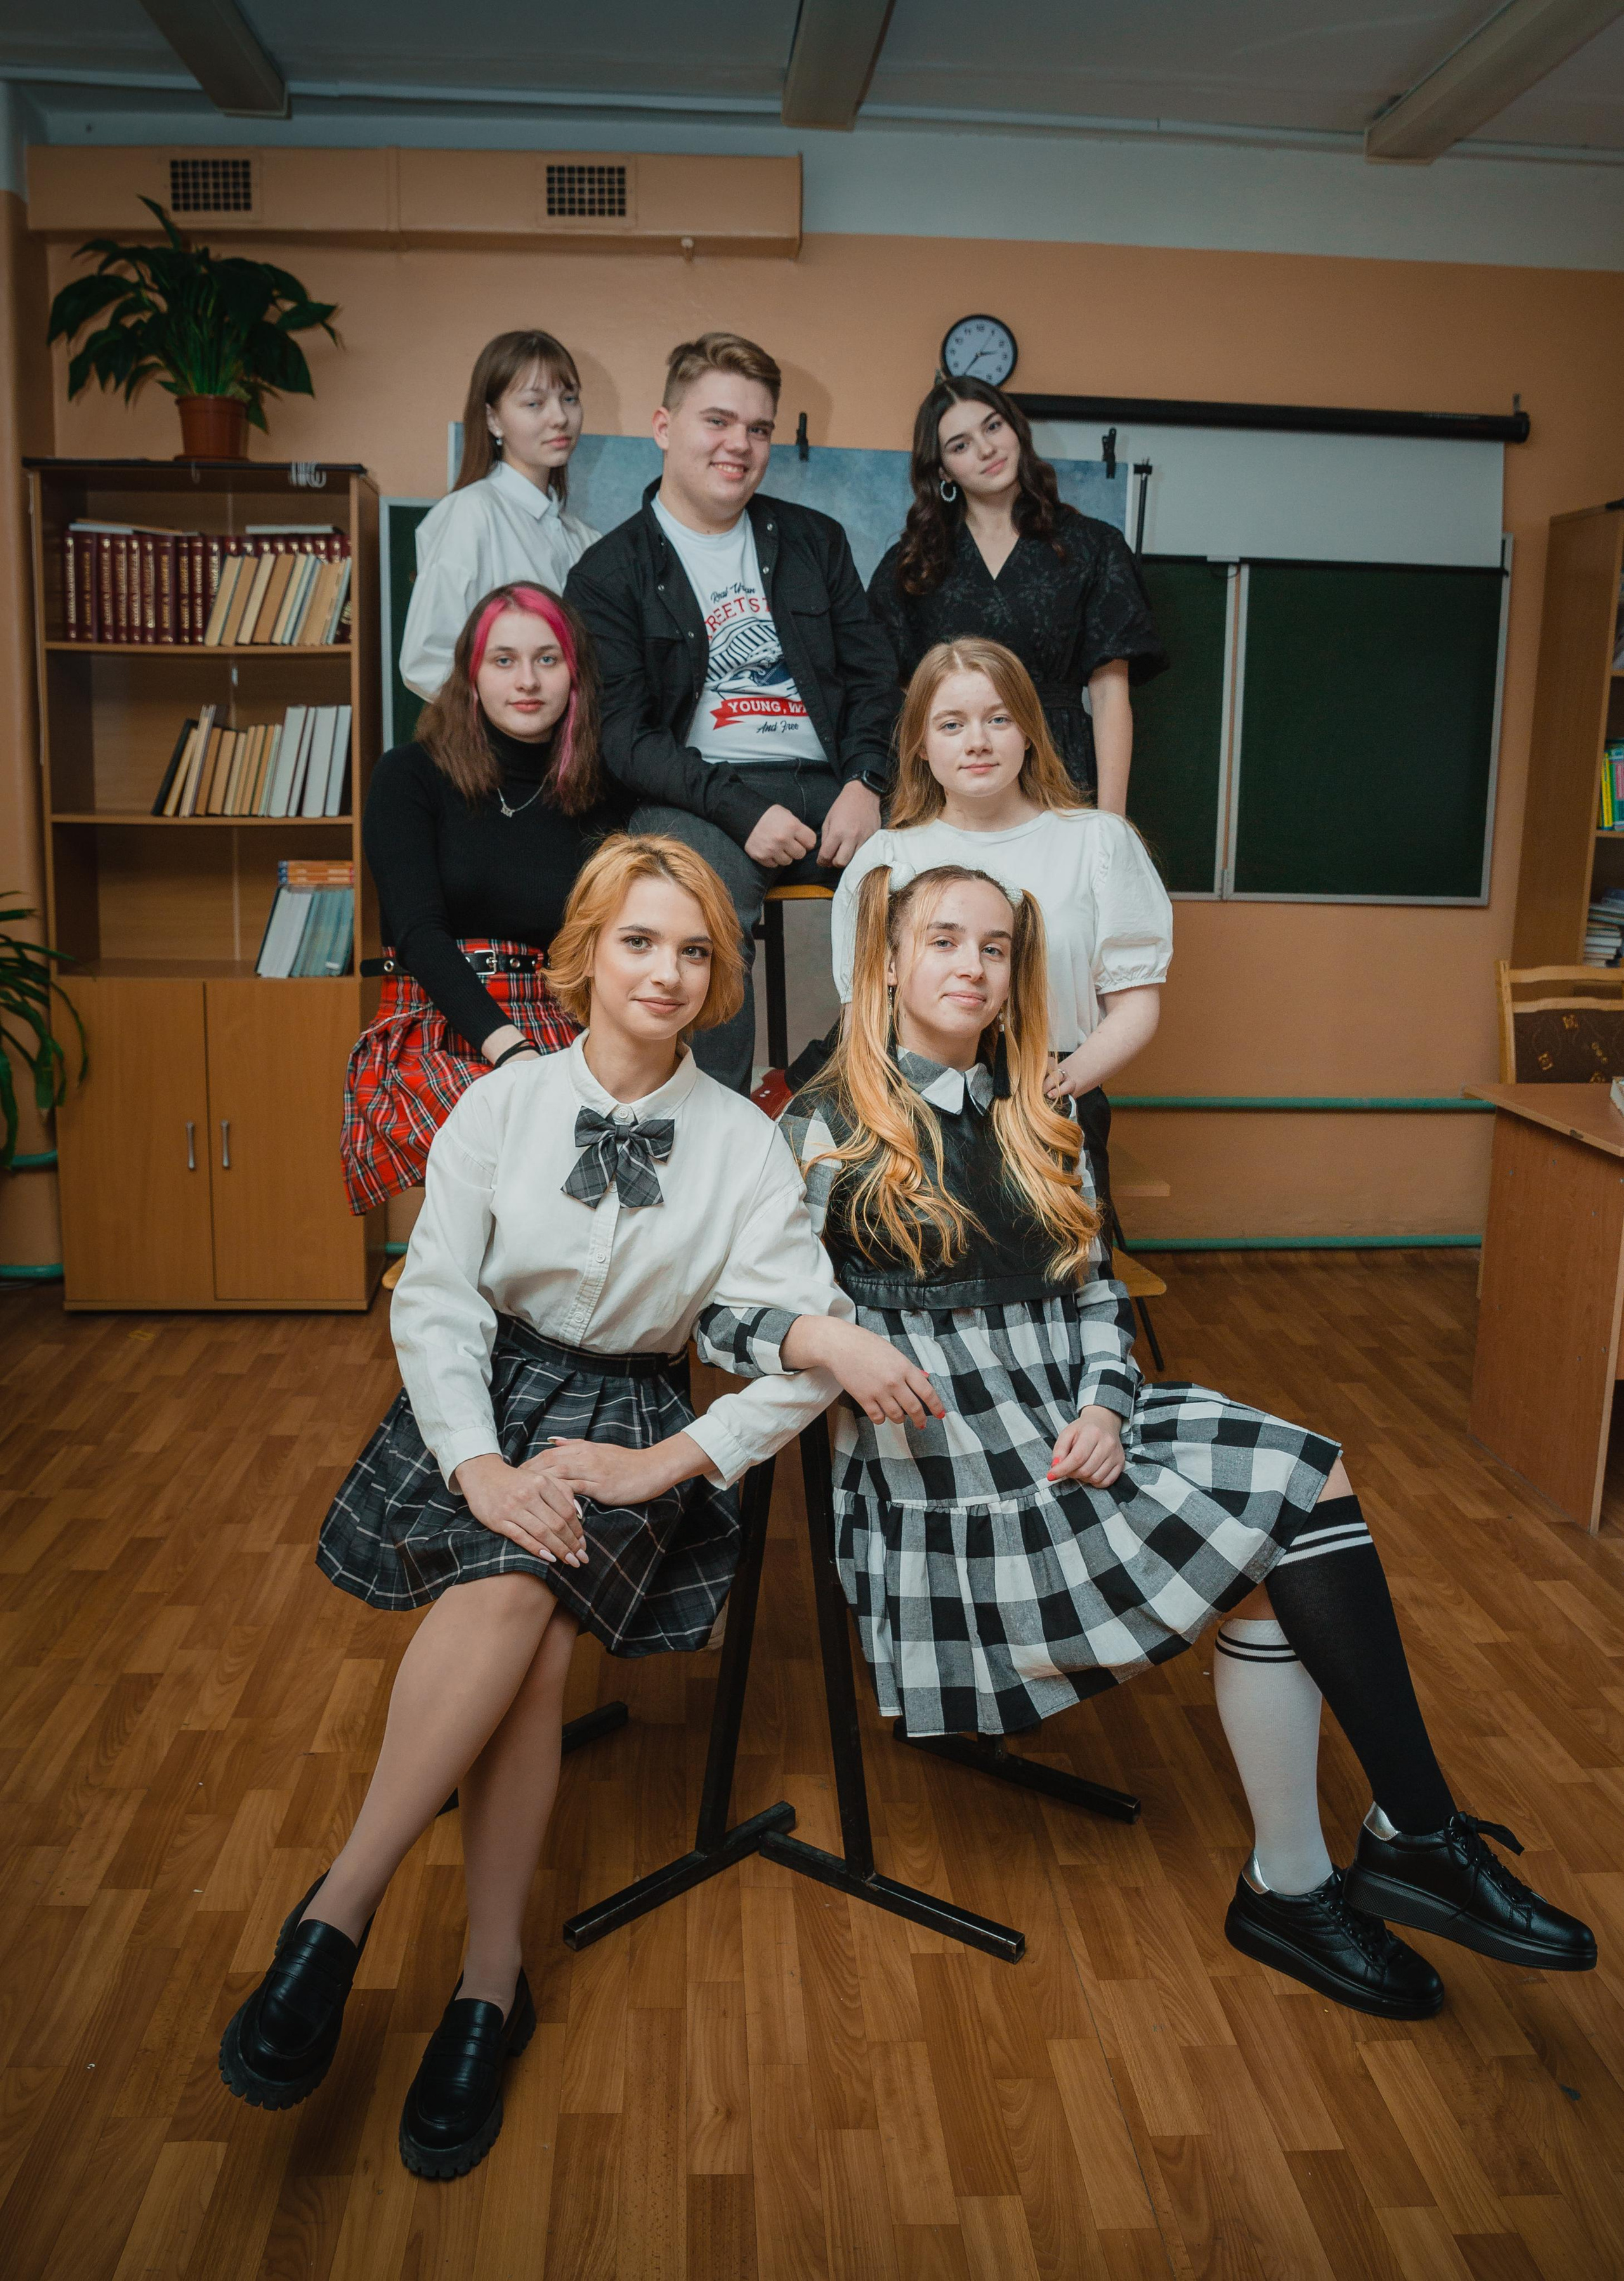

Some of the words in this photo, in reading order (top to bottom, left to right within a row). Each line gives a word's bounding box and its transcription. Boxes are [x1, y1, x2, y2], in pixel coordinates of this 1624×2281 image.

[705, 597, 770, 640] REETS
[756, 721, 778, 734] And
[780, 720, 799, 733] Free
